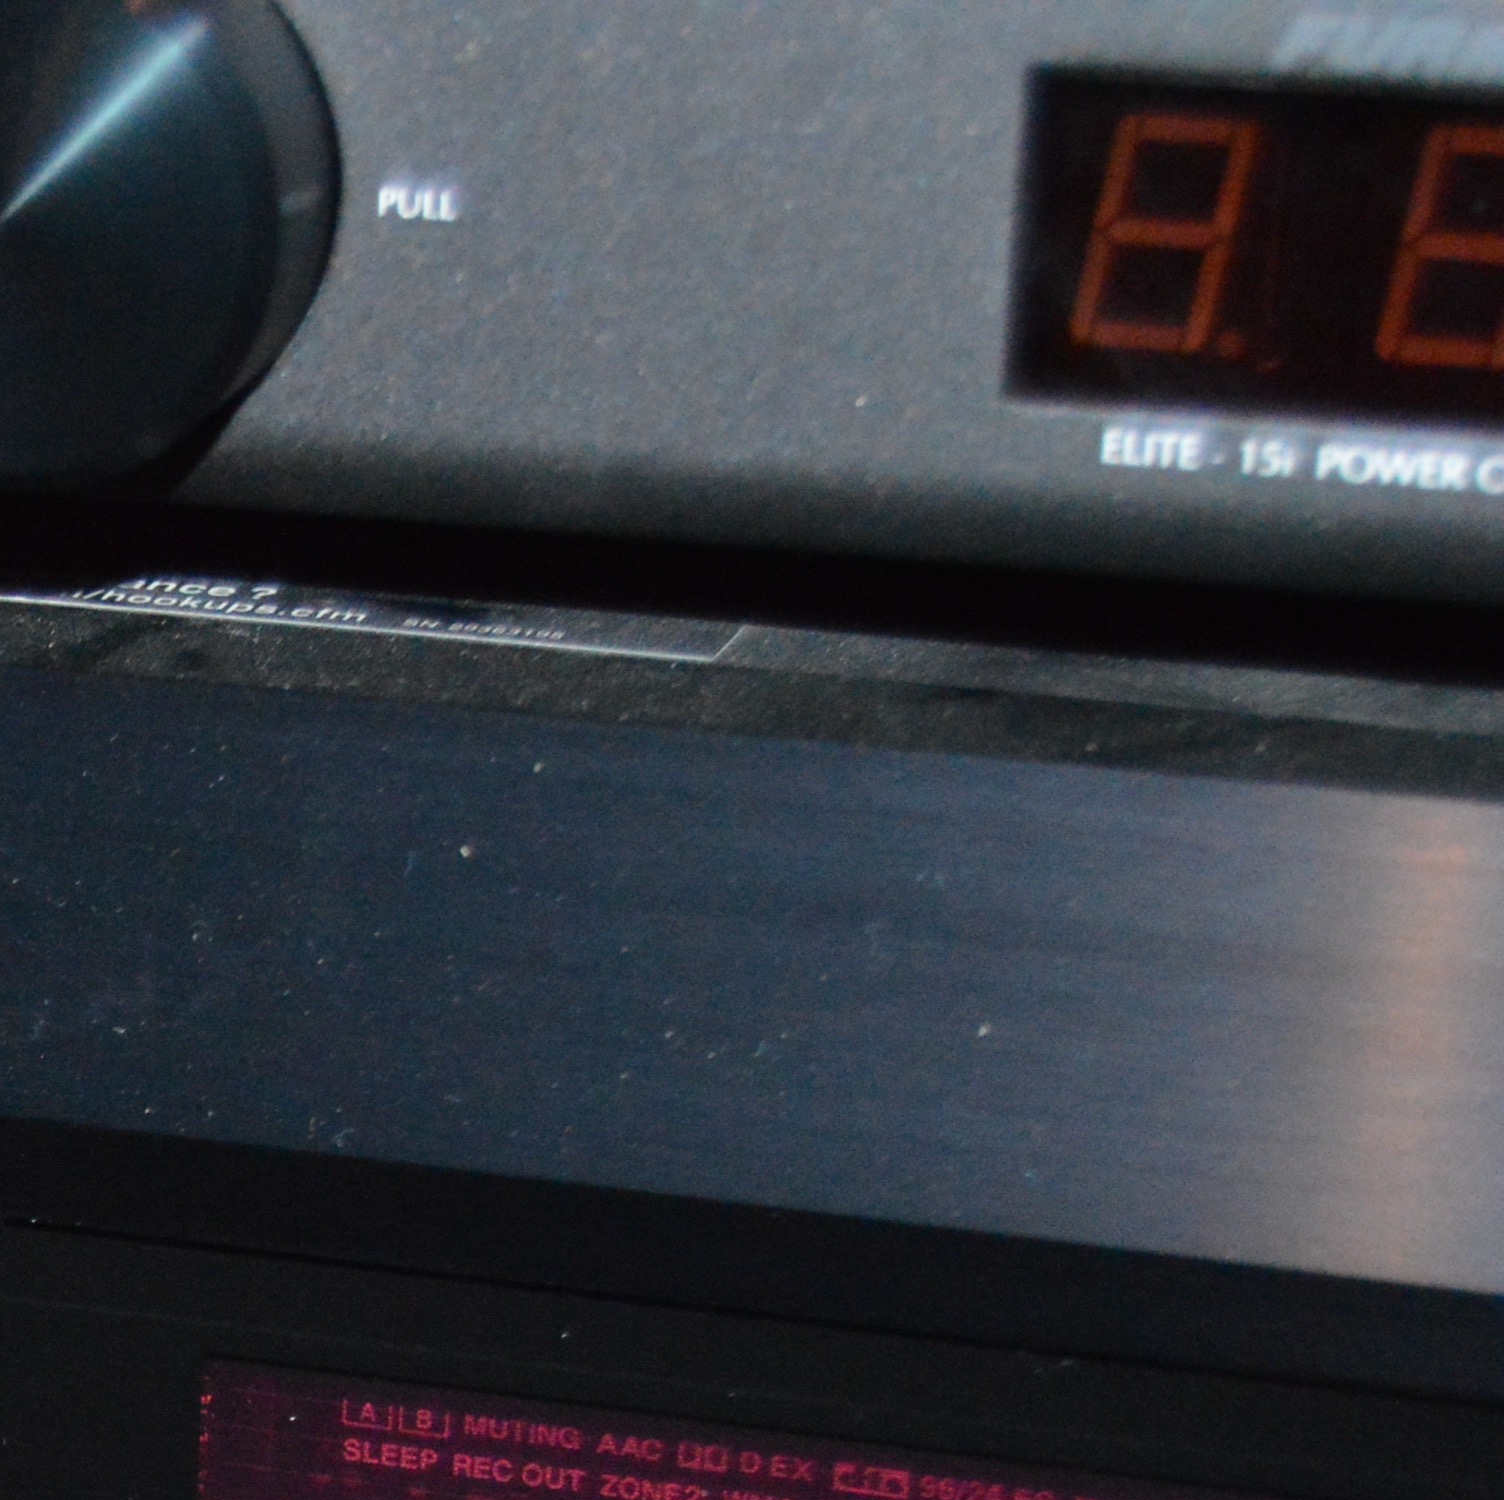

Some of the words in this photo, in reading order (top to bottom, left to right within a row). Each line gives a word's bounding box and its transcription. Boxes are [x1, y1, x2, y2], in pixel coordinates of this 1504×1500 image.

[378, 185, 458, 222] PULL
[1101, 427, 1200, 471] ELITE
[1316, 442, 1473, 491] POWER
[464, 1413, 584, 1451] MUTING
[596, 1432, 665, 1462] AAC
[344, 1438, 438, 1471] SLEEP
[453, 1453, 513, 1484] REC
[522, 1462, 587, 1492] OUT
